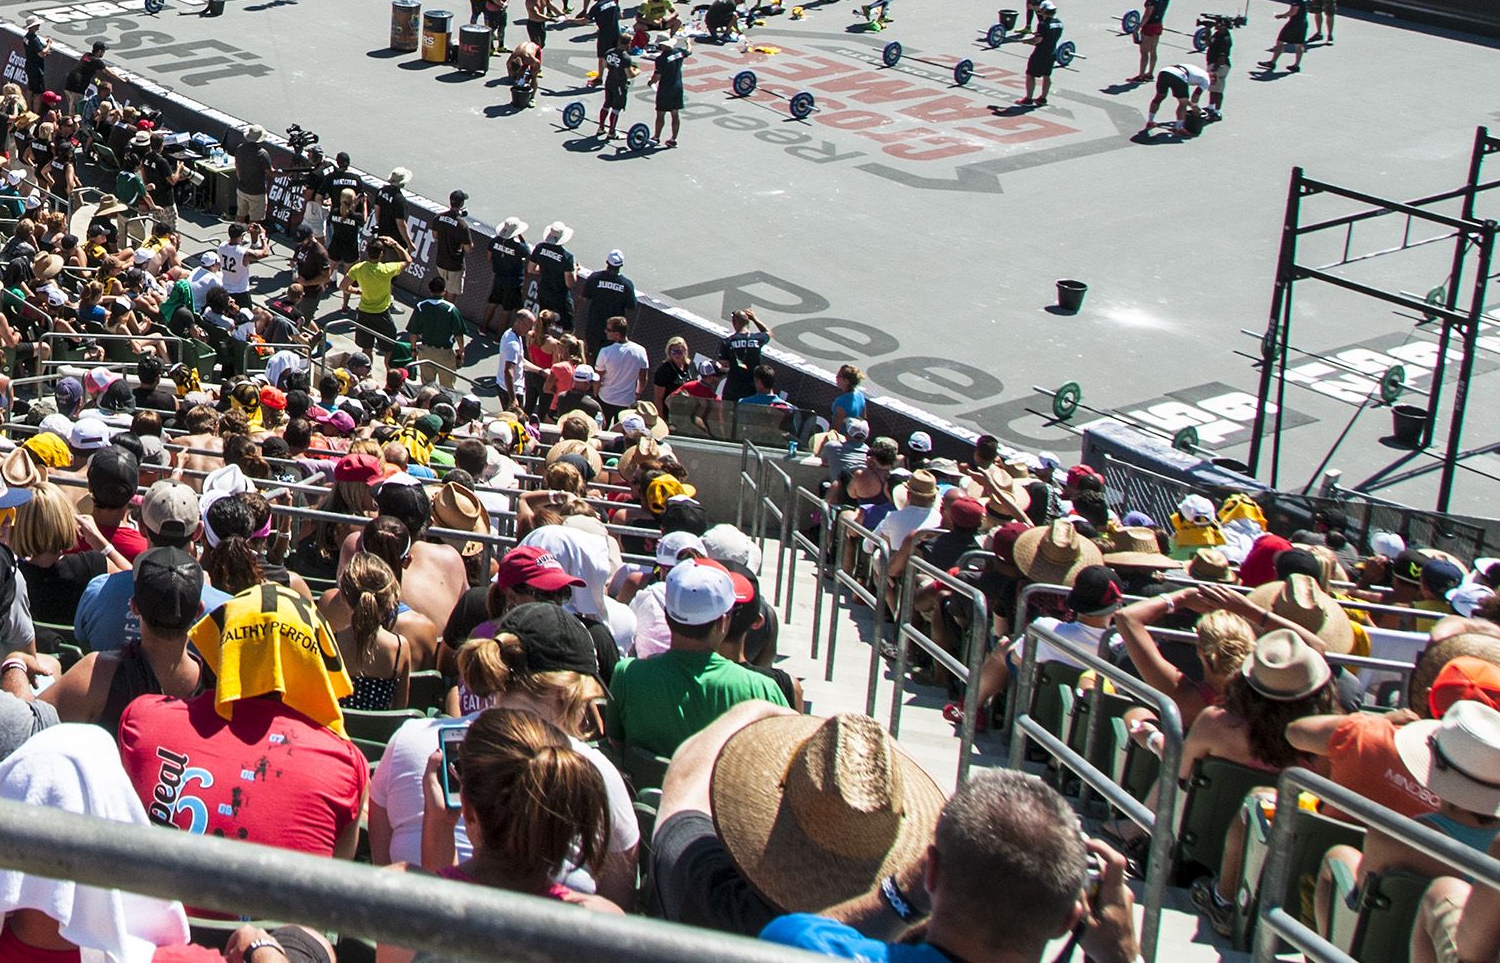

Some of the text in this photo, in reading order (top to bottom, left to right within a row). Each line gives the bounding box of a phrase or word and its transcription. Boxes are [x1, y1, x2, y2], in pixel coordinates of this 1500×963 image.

[8, 50, 27, 68] Cross
[539, 247, 564, 263] JUDGE
[596, 279, 625, 293] JUDGE
[731, 339, 760, 349] JUDGE
[661, 269, 1100, 452] Reeb
[220, 620, 321, 657] EALTHY PERFOR
[463, 695, 480, 711] EAT
